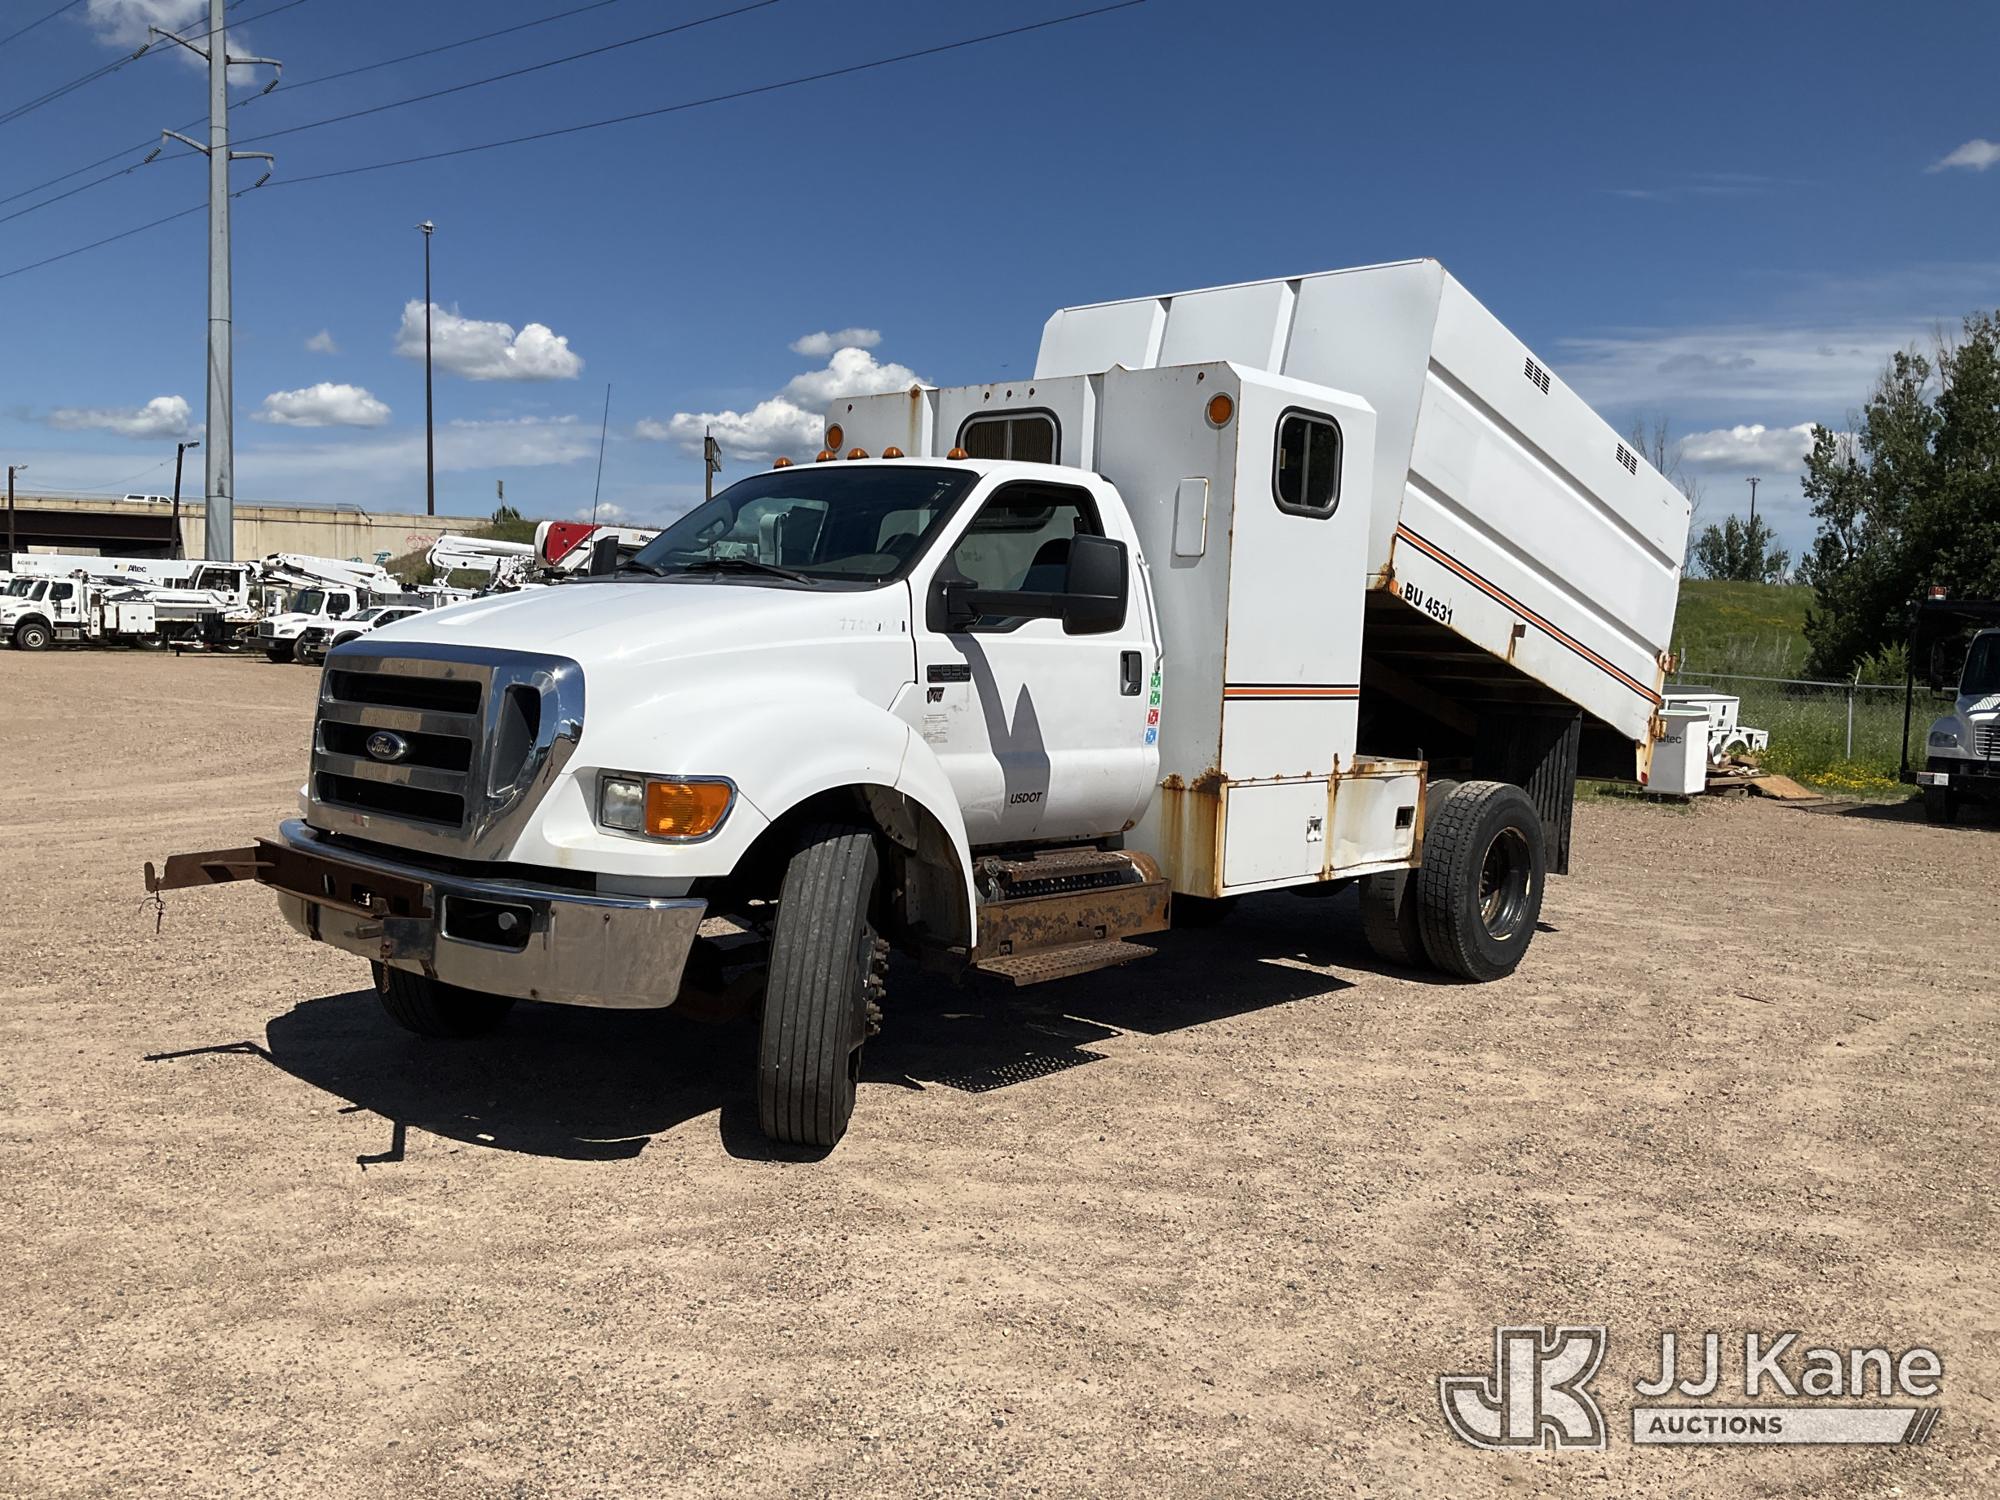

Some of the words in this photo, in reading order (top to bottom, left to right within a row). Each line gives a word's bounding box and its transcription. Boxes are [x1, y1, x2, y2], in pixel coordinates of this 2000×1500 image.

[127, 564, 147, 573] Altec
[1404, 582, 1423, 606] BU
[1425, 597, 1452, 625] 4531
[371, 736, 392, 754] Ford
[1010, 791, 1043, 804] USDOT
